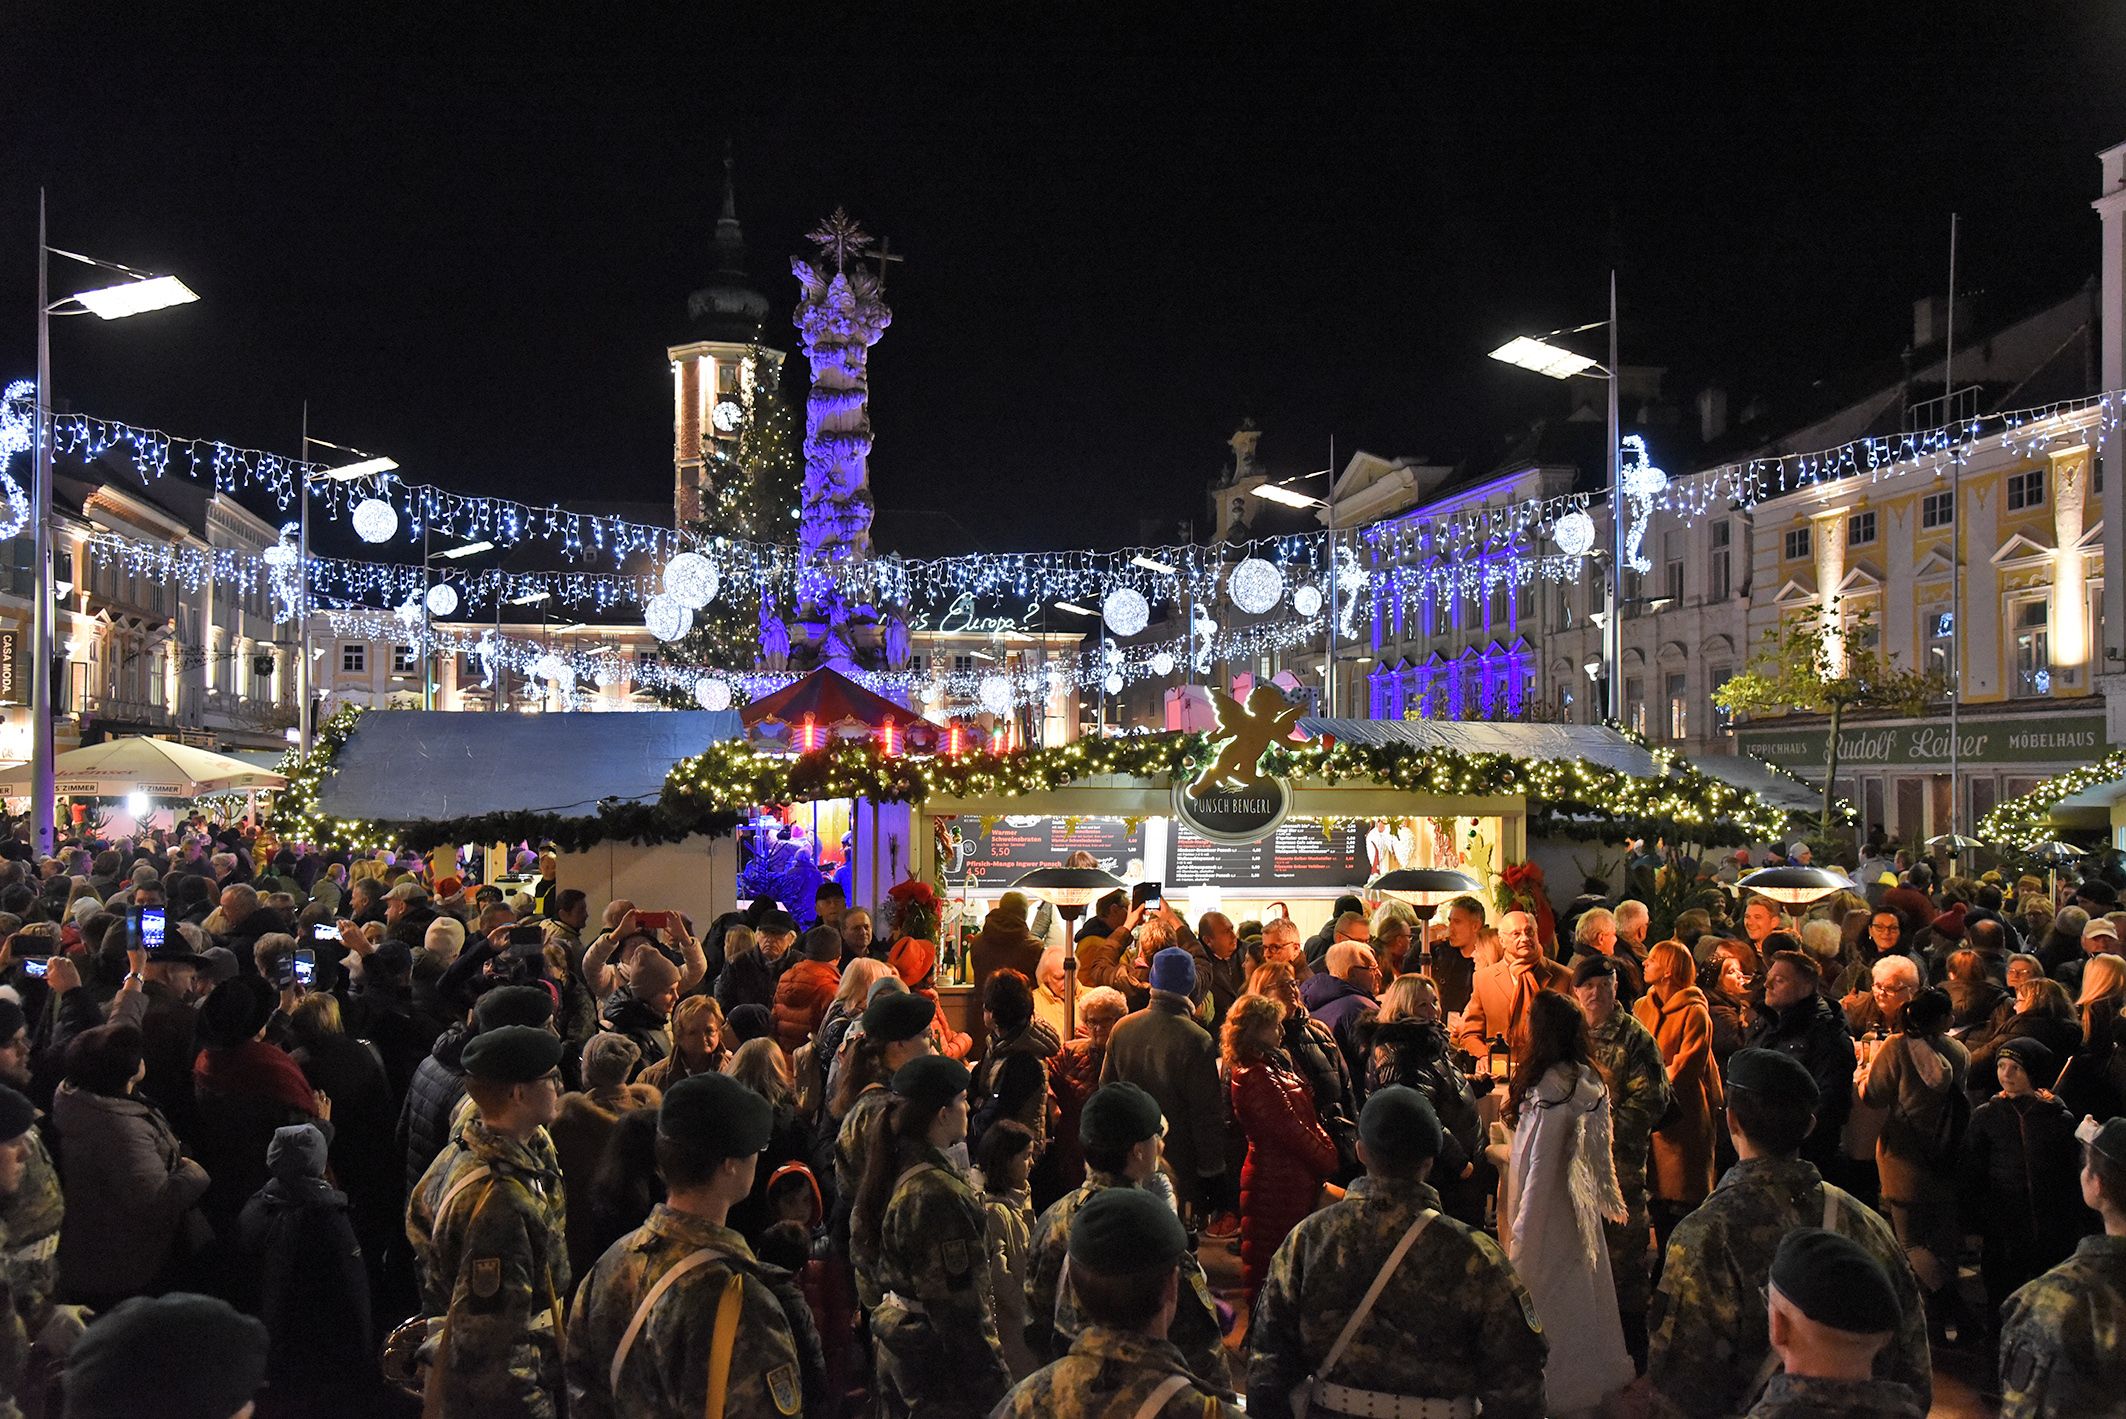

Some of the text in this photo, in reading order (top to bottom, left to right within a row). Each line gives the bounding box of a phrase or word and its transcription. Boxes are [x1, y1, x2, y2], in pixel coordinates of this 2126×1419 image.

[940, 591, 1040, 643] Europa?
[2, 634, 12, 661] CASA
[1823, 727, 1988, 761] Rudolf Leiner
[2009, 730, 2095, 749] MÖBELHAUS
[1746, 742, 1807, 755] TEPPICHHAUS
[1193, 798, 1271, 814] PUNSCH BENGERL
[991, 847, 1010, 857] 5,50
[966, 860, 1015, 868] Pfirsich-Mango
[966, 867, 986, 876] 450
